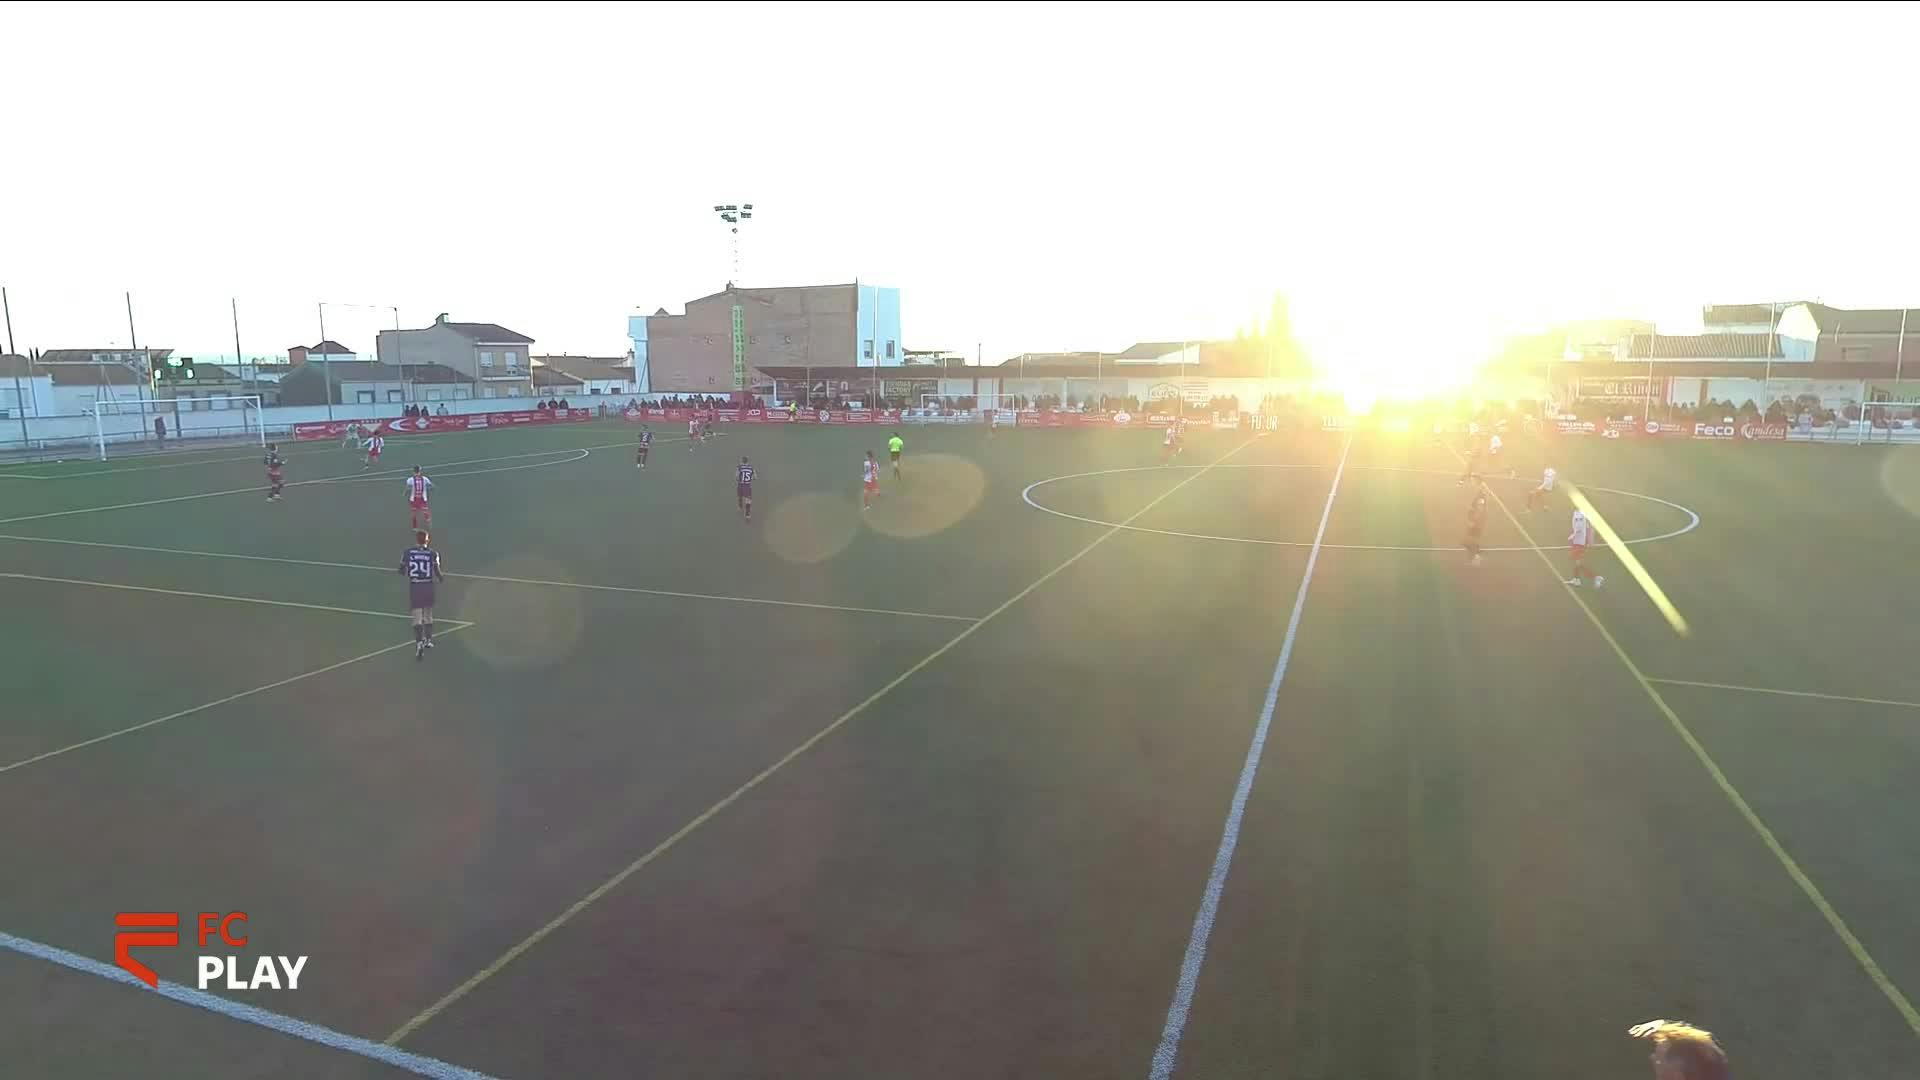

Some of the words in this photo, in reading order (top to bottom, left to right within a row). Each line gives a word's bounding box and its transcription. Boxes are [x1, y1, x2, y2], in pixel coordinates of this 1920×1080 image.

[1694, 423, 1735, 436] Feco
[742, 471, 751, 481] 15
[409, 562, 431, 577] 24
